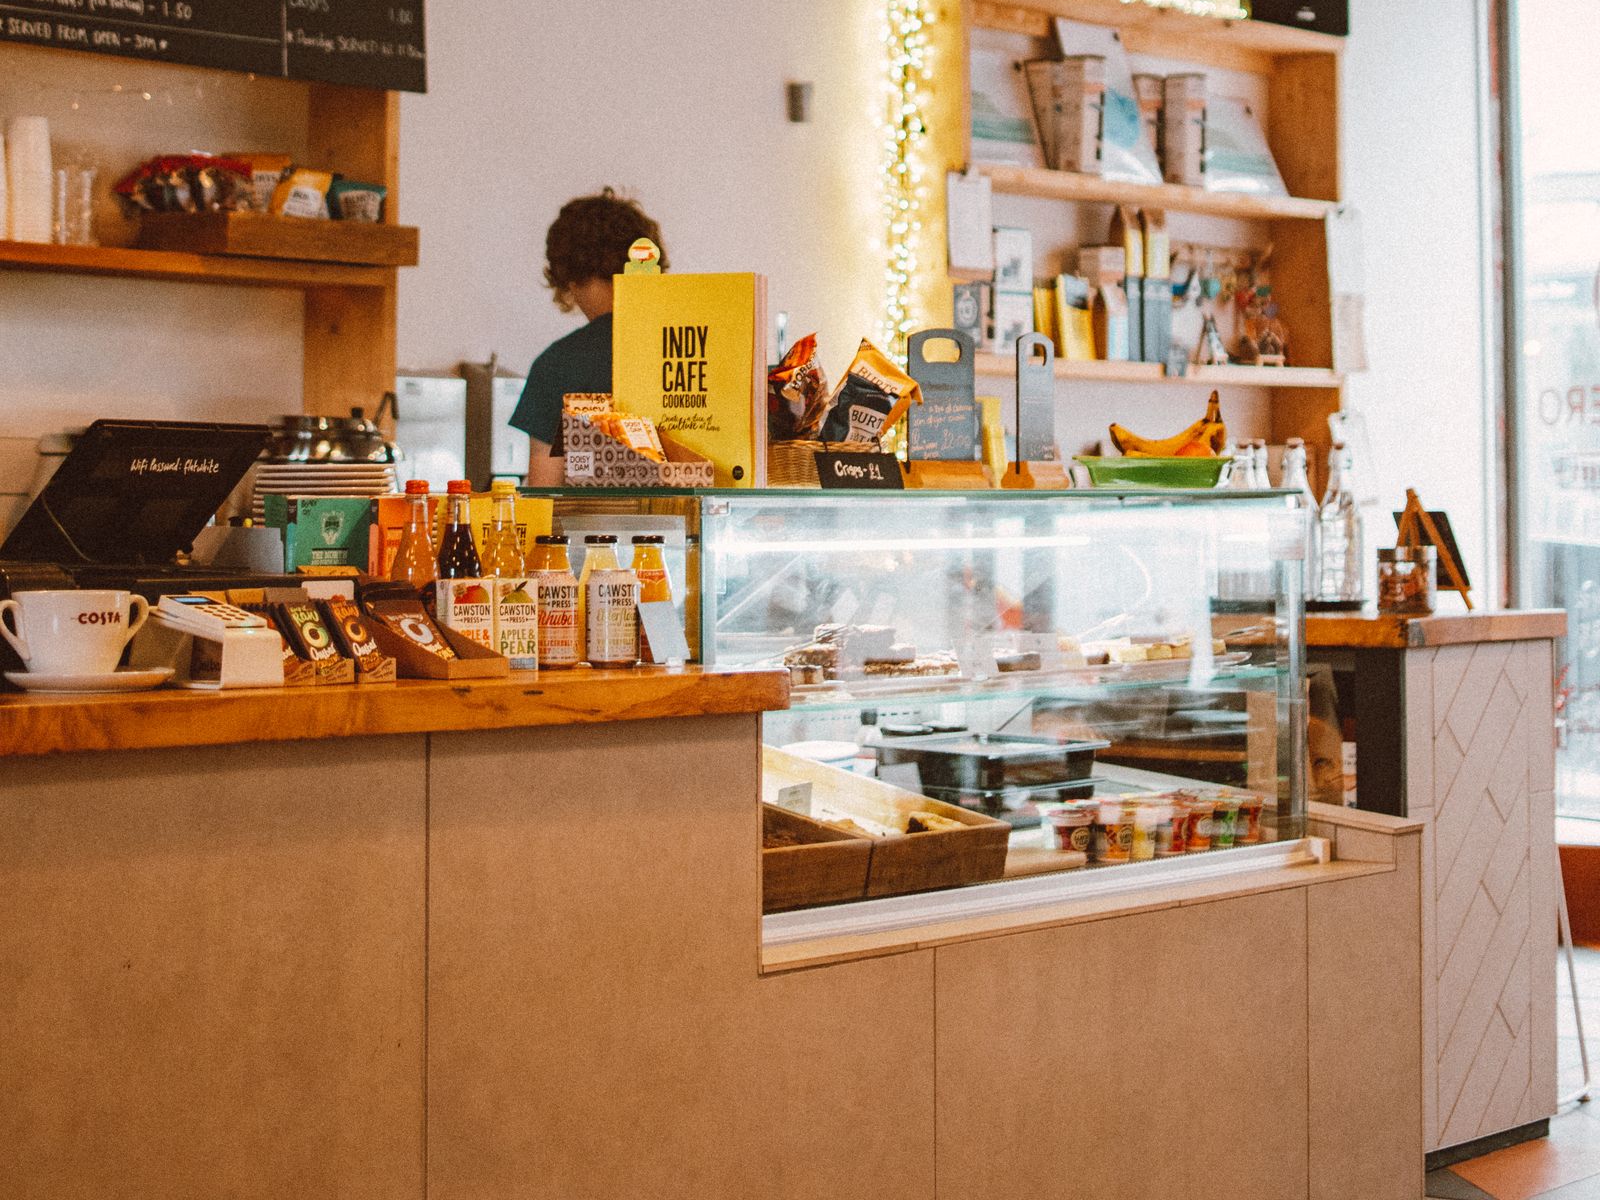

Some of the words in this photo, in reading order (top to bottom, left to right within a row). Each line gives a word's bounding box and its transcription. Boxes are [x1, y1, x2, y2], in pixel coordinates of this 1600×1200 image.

[8, 17, 52, 39] SERVED
[56, 23, 89, 44] FROM
[92, 30, 121, 47] OPEN
[662, 325, 708, 359] INDY
[662, 361, 708, 392] CAFE
[662, 394, 707, 408] COOKBOOK
[668, 417, 698, 431] culture
[570, 455, 590, 464] DOISY
[552, 600, 571, 608] PRESS
[612, 598, 632, 607] PRESS
[453, 604, 491, 616] CAWSTON
[499, 604, 536, 616] CAWSTON
[78, 612, 120, 625] COSTA
[482, 629, 490, 640] &
[501, 629, 527, 640] APPLE
[528, 629, 535, 640] &
[500, 641, 536, 655] PEAR
